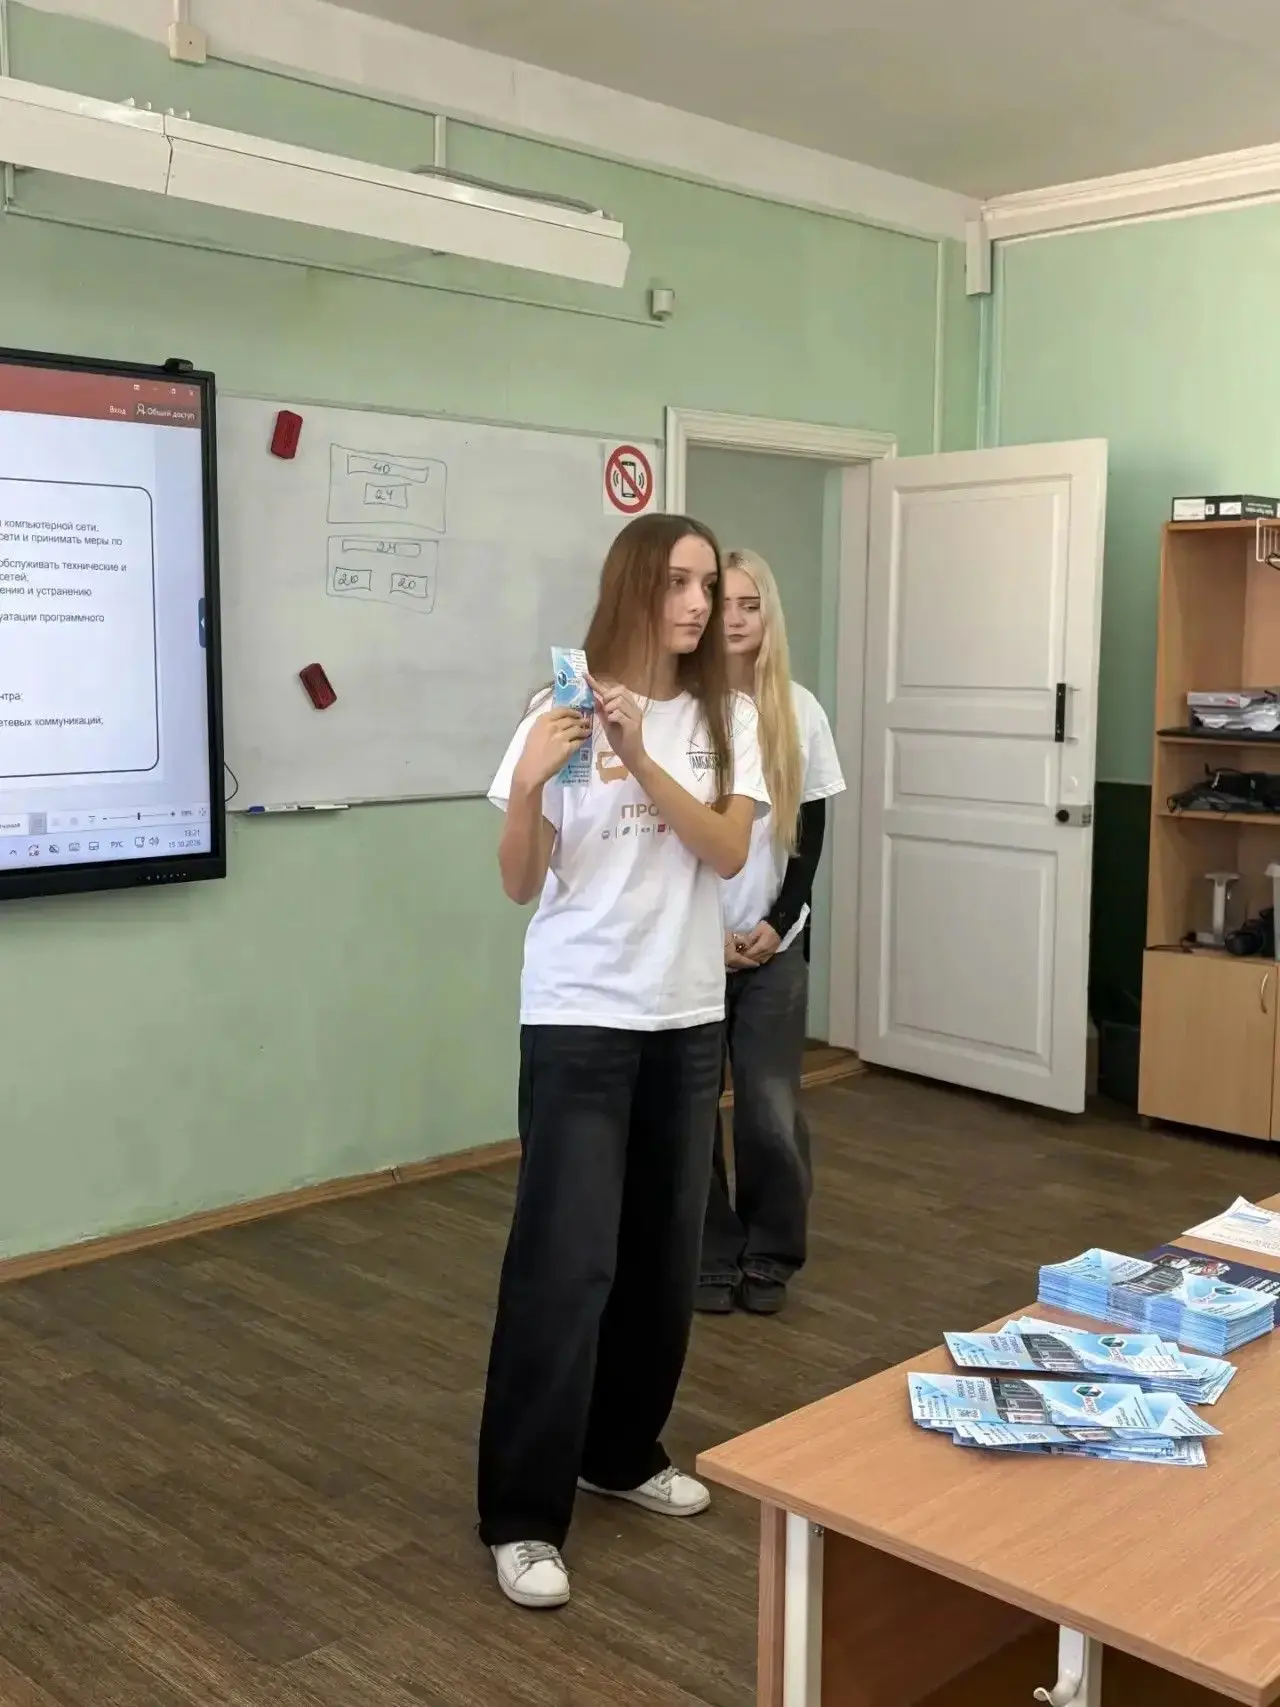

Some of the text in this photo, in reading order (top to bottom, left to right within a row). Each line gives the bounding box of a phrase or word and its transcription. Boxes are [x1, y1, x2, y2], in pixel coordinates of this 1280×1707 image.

[109, 405, 127, 415] Вход
[147, 407, 195, 421] Общий доступ
[4, 519, 74, 532] компьютерной
[31, 534, 82, 545] принимать
[84, 537, 109, 546] меры
[111, 538, 123, 546] по
[62, 561, 119, 572] технические
[36, 587, 92, 598] устранению
[39, 613, 105, 624] программного
